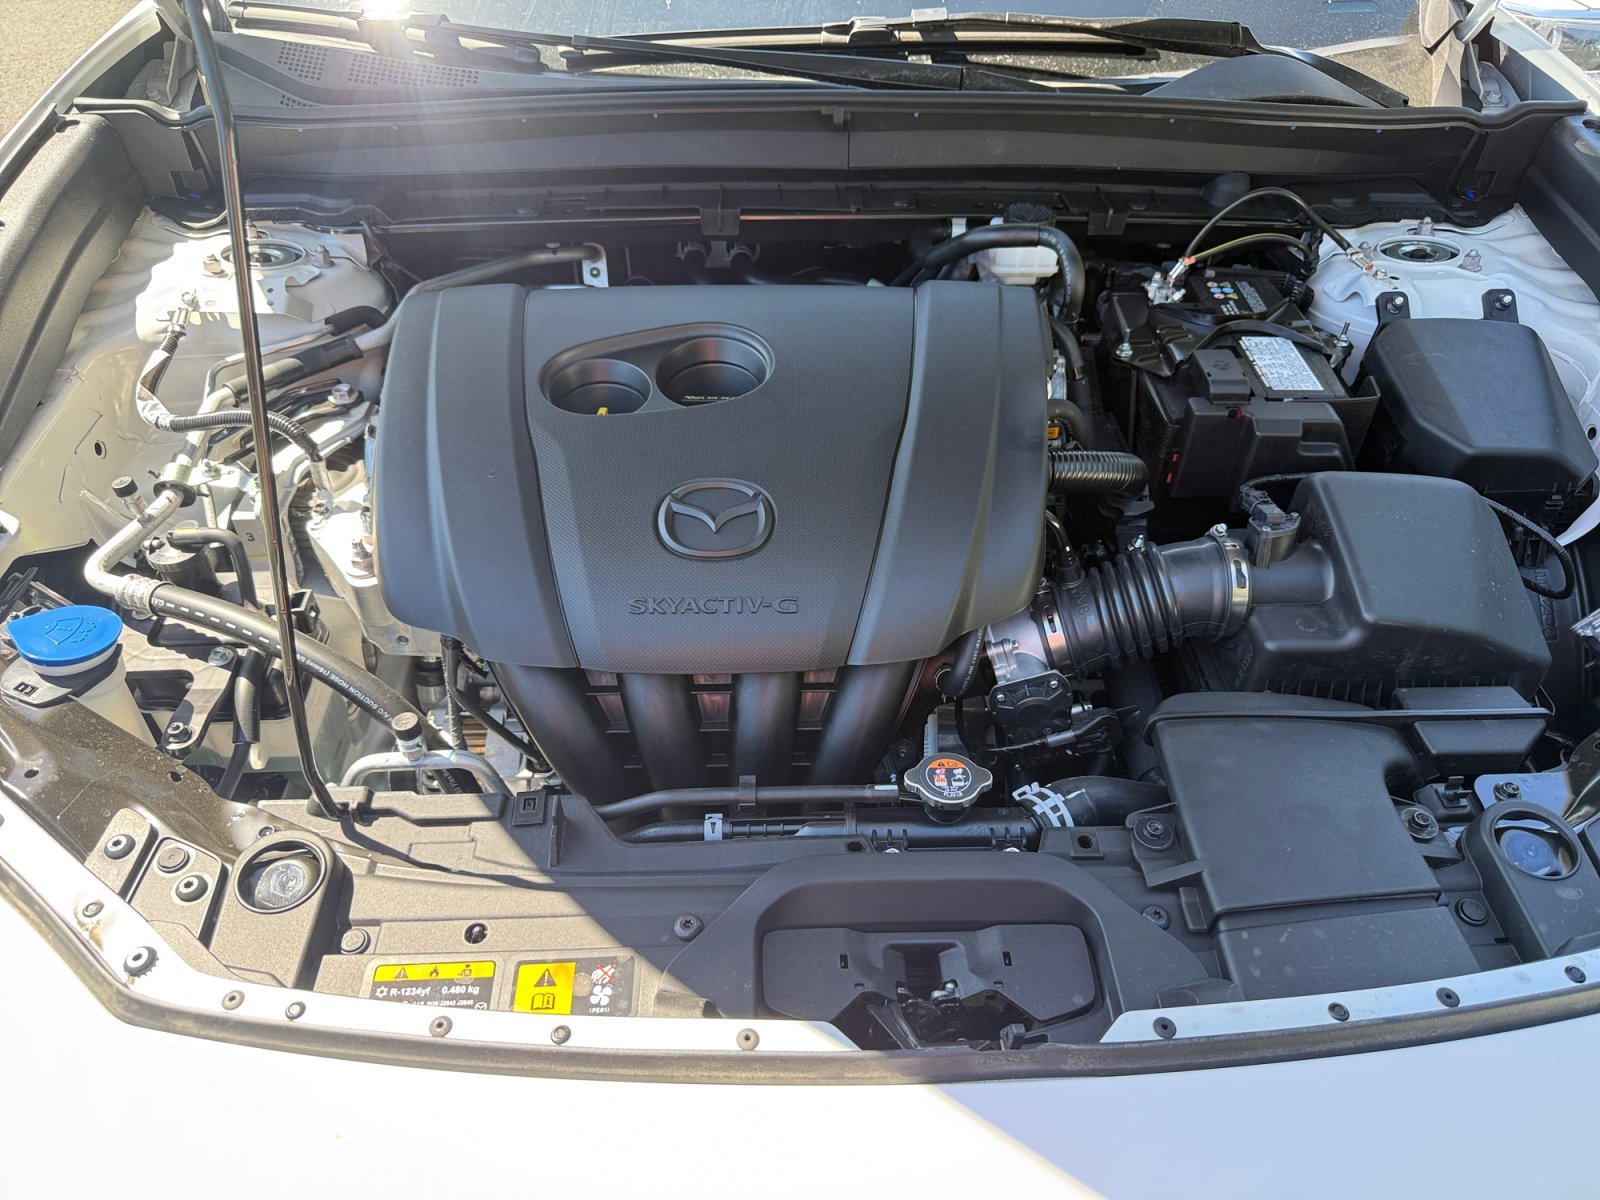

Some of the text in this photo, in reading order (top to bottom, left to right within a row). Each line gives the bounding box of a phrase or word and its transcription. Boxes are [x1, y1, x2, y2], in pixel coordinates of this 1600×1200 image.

[246, 532, 255, 542] 3
[628, 597, 798, 615] SKYACTIV-G
[329, 673, 349, 689] HOSE
[348, 684, 379, 710] SUCTION
[390, 986, 431, 997] R-1234yf
[467, 984, 480, 995] kg
